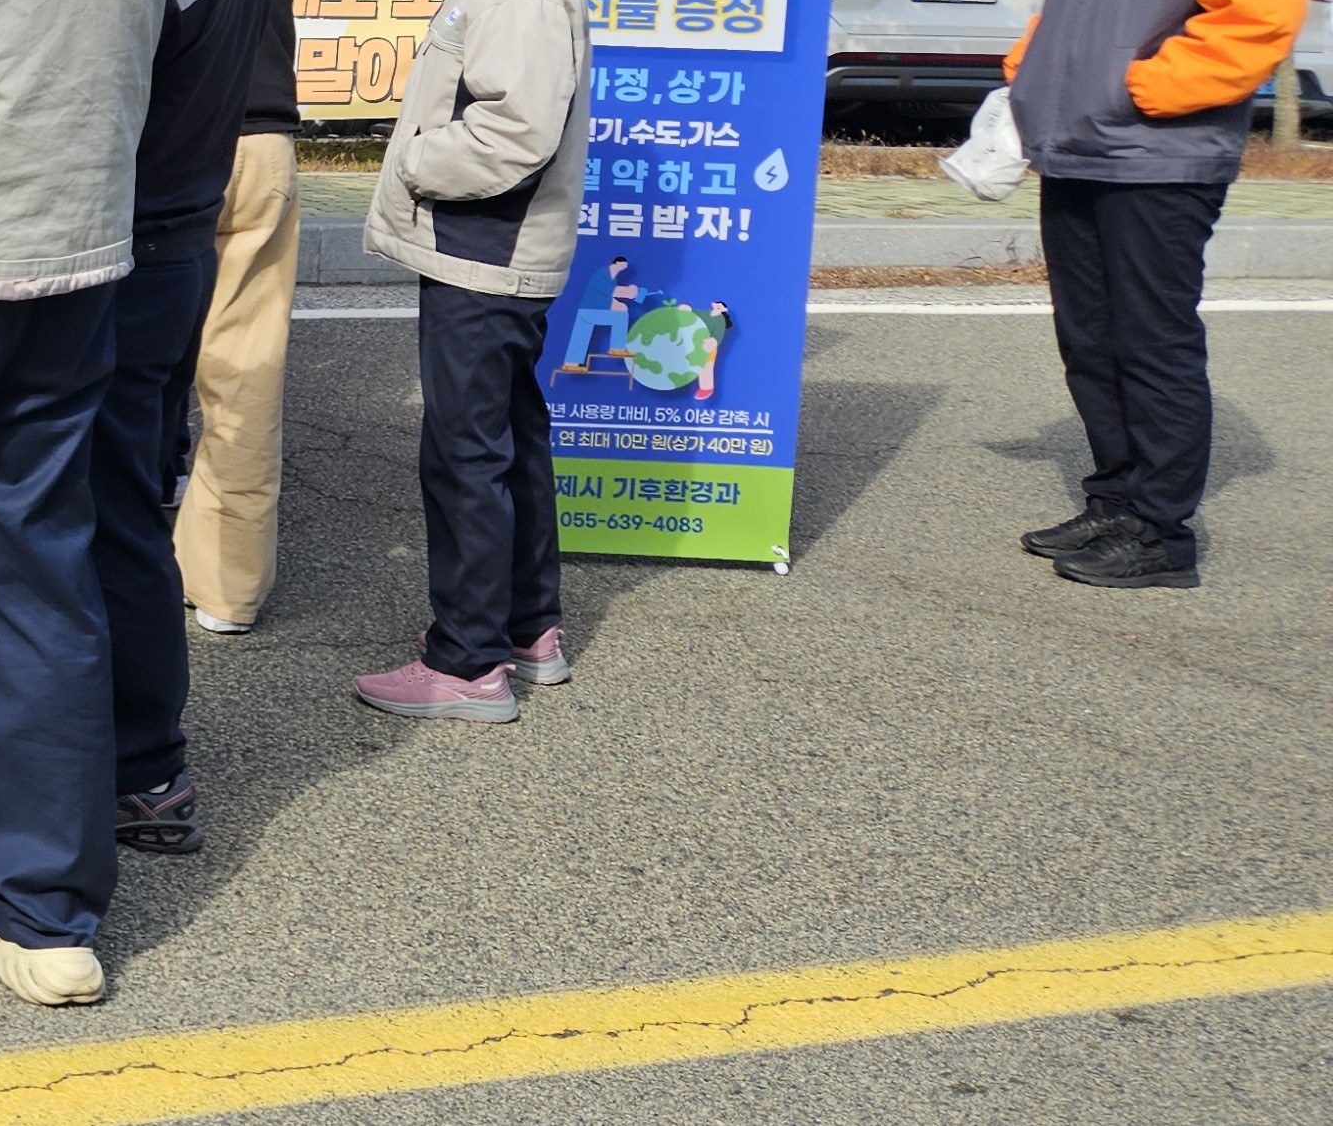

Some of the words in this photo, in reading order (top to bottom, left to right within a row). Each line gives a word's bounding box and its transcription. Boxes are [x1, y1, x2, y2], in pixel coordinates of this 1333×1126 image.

[569, 403, 615, 421] 사용량
[618, 406, 651, 424] 대비,
[655, 407, 680, 424] 5%
[685, 408, 715, 425] 이상
[719, 410, 750, 427] 감축
[753, 411, 770, 428] 시
[559, 430, 575, 448] 연
[578, 431, 610, 449] 최대
[614, 432, 648, 450] 10만
[555, 474, 603, 500] 제시
[613, 476, 742, 506] 기후환경과
[560, 511, 704, 534] 055-639-4083
